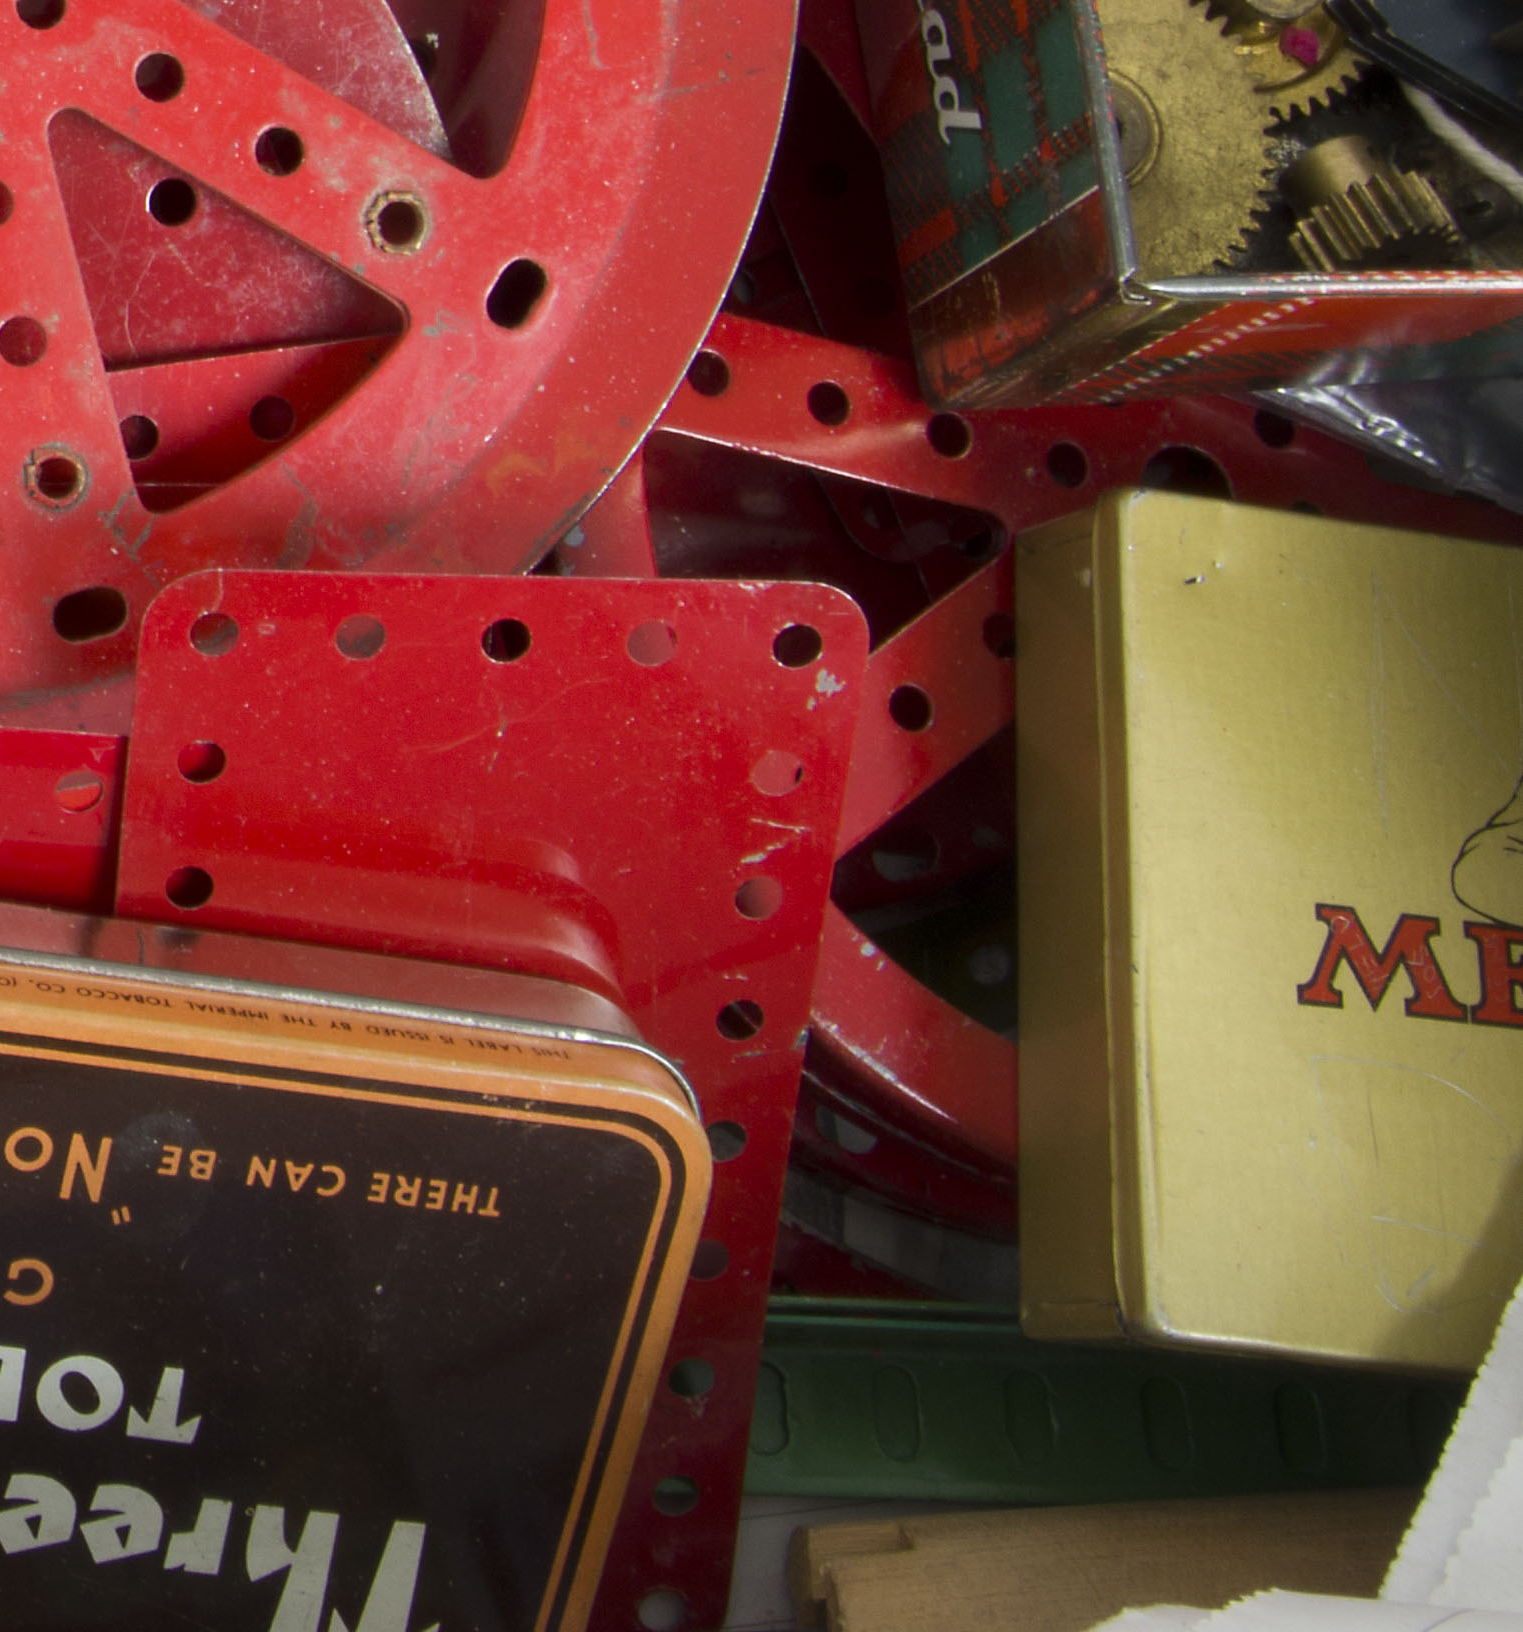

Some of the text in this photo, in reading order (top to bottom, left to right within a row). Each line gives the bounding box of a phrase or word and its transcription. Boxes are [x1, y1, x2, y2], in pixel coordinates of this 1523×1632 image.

[29, 977, 67, 995] CO.
[75, 985, 172, 1009] TOBACCO
[186, 999, 270, 1022] IMPERIAL
[282, 1012, 316, 1028] THE
[329, 1019, 352, 1032] BY
[365, 1024, 431, 1043] ISSUED
[439, 1033, 457, 1048] IS
[468, 1037, 523, 1054] LABEL
[156, 1143, 218, 1180] BE
[246, 1156, 347, 1197] CAN
[367, 1172, 503, 1218] THERE
